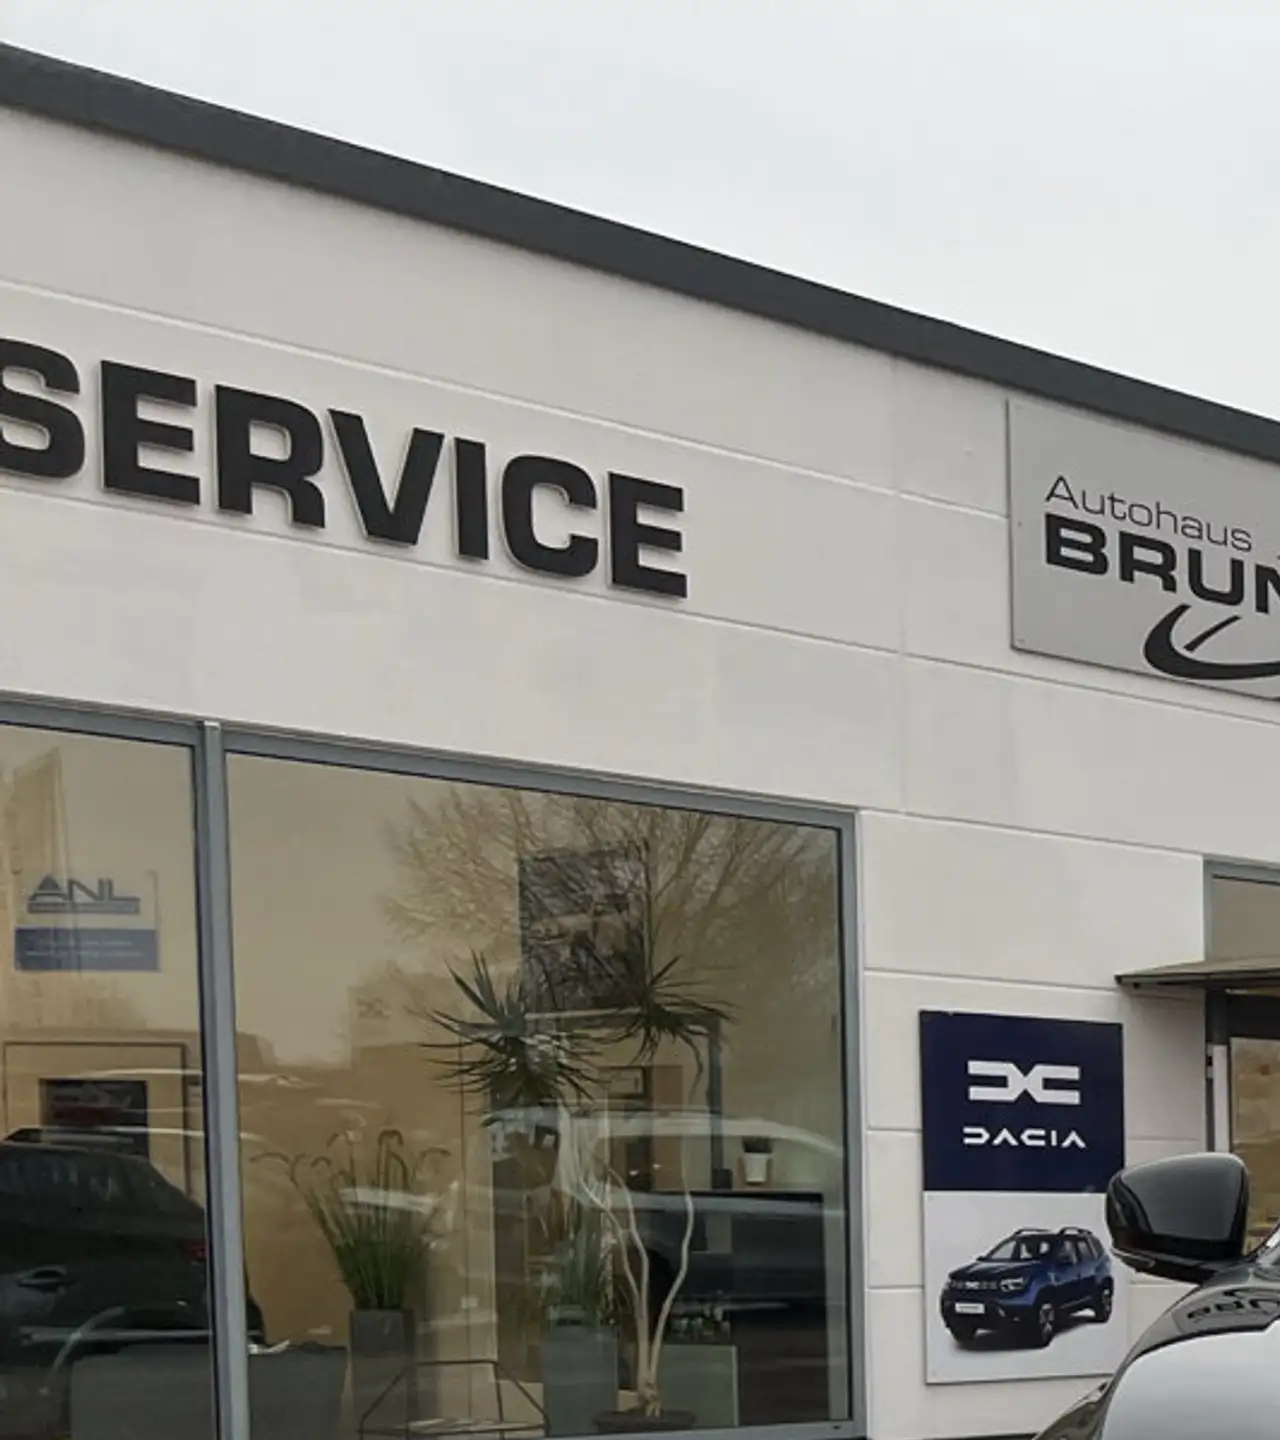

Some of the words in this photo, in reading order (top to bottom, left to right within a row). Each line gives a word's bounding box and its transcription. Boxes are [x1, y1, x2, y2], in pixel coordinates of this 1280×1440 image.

[0, 338, 688, 598] SERVICE
[1045, 475, 1253, 552] Autohaus
[962, 1126, 1087, 1149] DACIA
